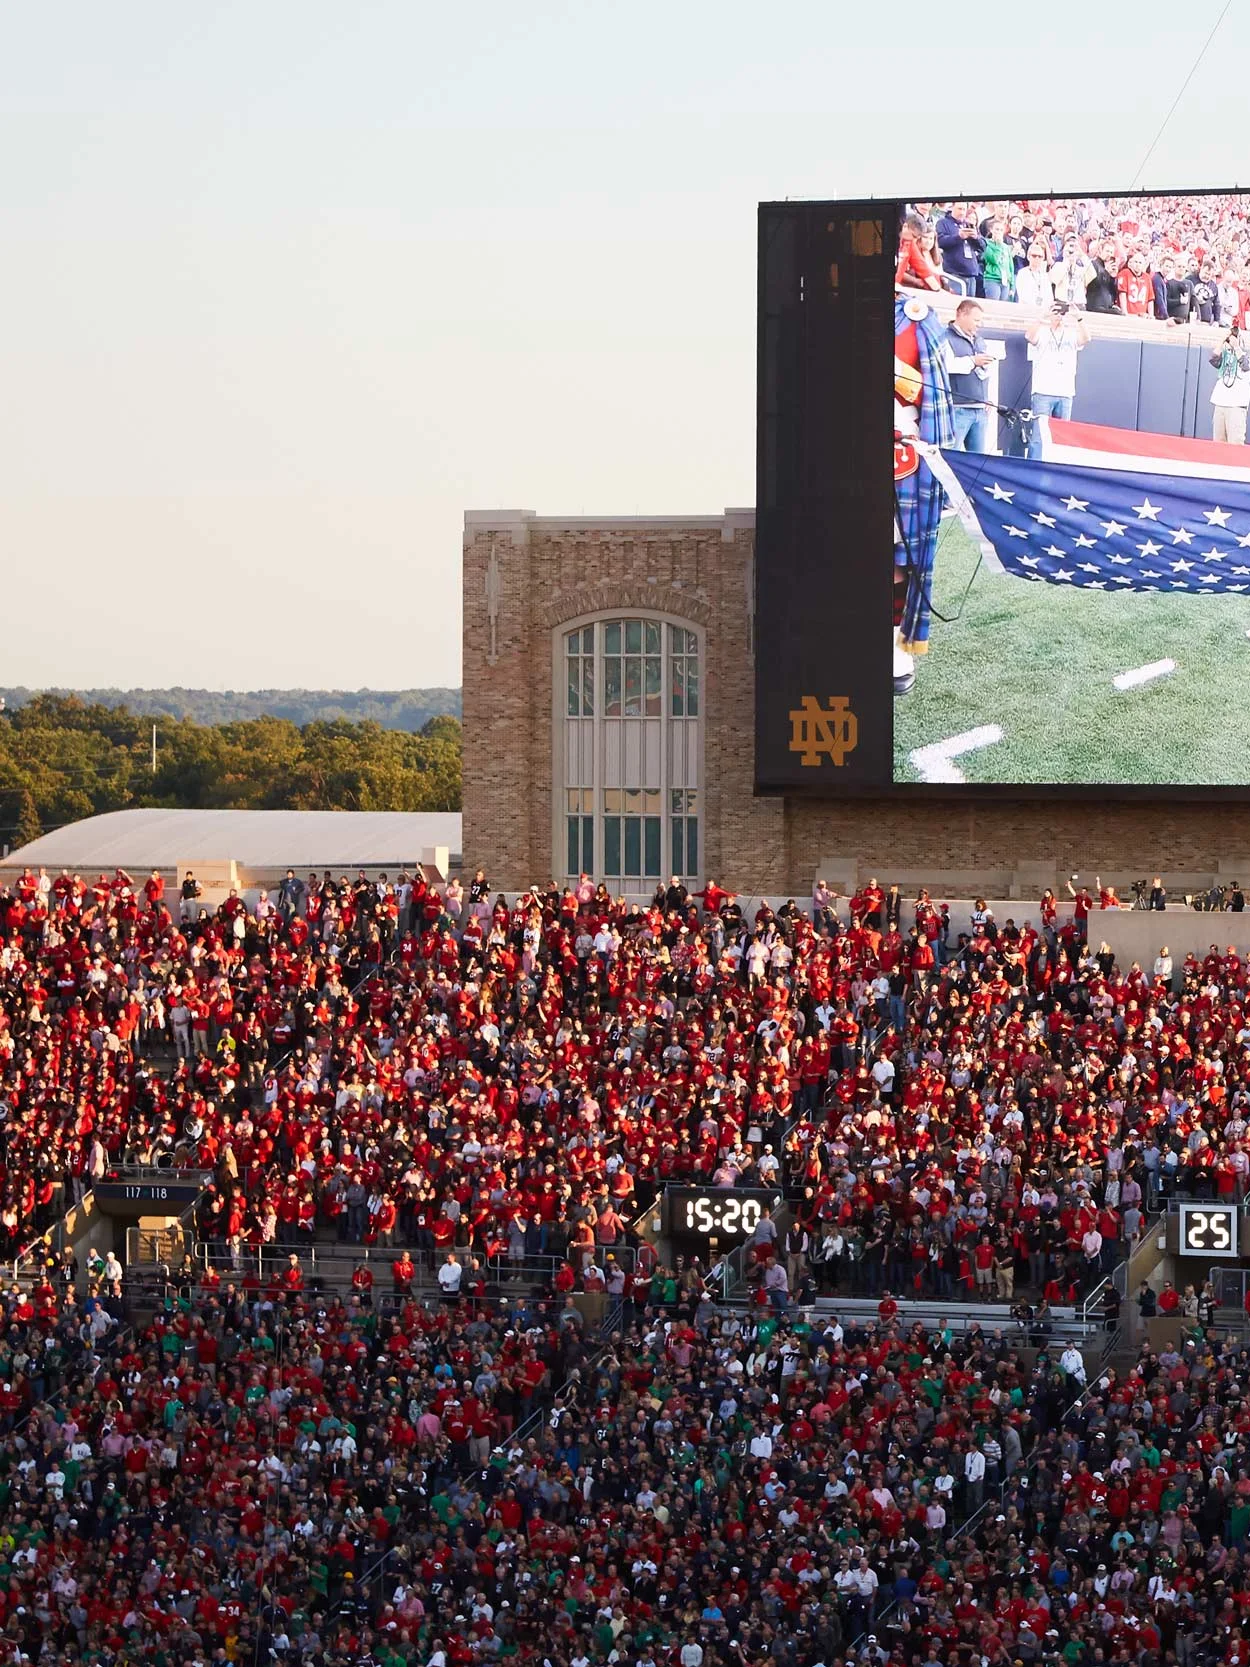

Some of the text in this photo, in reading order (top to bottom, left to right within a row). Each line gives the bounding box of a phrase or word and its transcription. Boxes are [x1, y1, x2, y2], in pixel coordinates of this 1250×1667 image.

[403, 943, 412, 952] 34
[126, 1186, 167, 1199] 117 118
[686, 1198, 760, 1234] 15:20
[1188, 1213, 1229, 1248] 25
[482, 1471, 488, 1480] 5
[228, 1606, 240, 1617] 34
